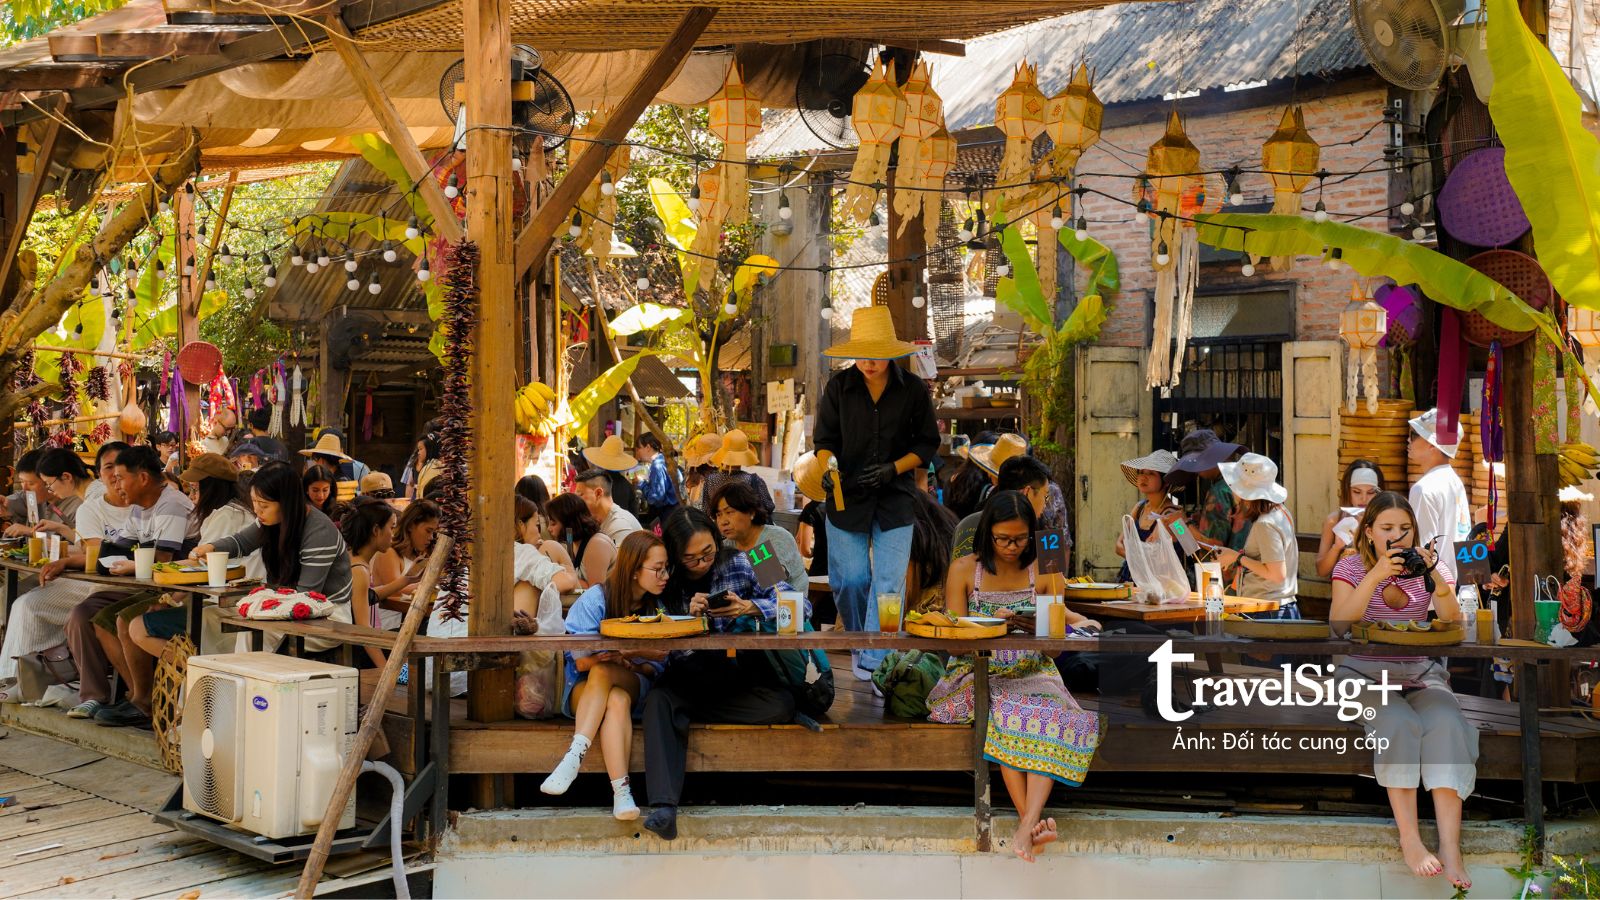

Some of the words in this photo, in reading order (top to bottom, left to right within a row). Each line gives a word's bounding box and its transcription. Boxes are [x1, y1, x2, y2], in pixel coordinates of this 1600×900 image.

[1172, 520, 1186, 536] 5
[1040, 533, 1060, 551] 12
[748, 543, 773, 567] 11
[1455, 542, 1489, 564] 40
